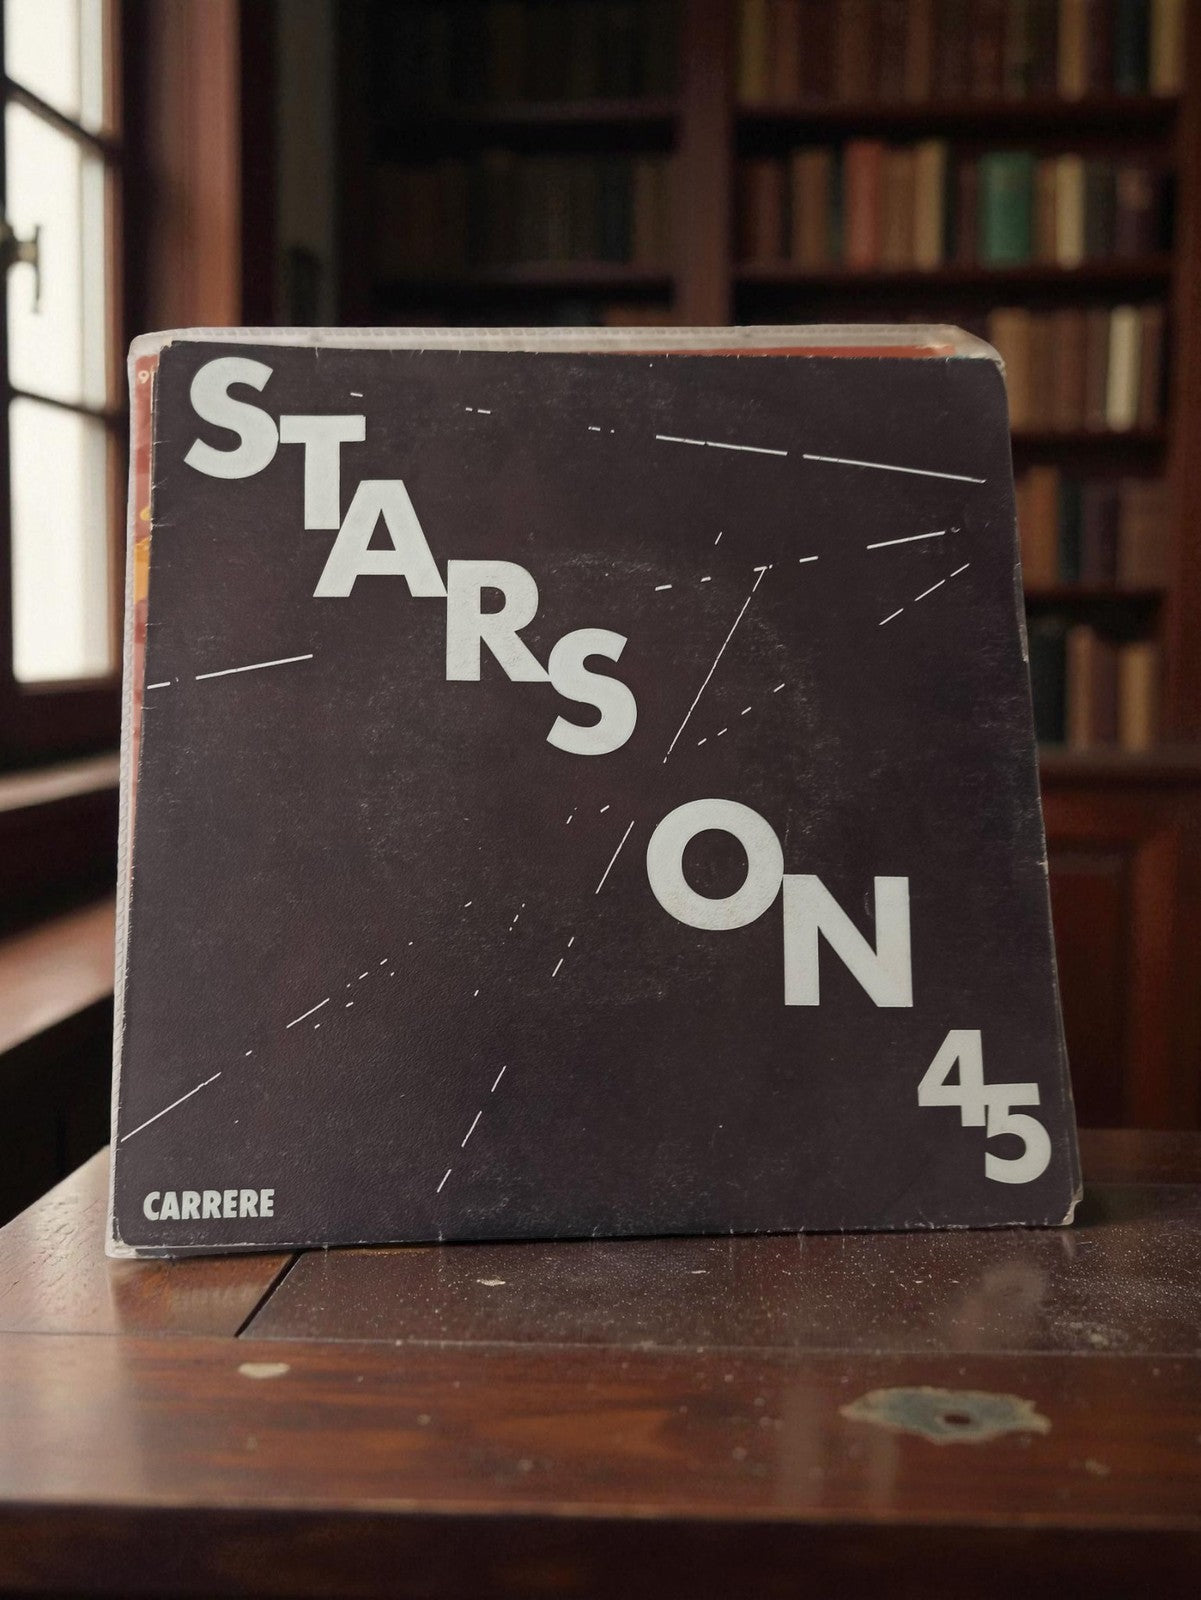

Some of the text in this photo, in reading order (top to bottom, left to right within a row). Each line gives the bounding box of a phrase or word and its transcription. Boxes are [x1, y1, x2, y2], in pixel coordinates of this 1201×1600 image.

[184, 357, 1051, 1184] STARS ON 45
[143, 1189, 275, 1221] CARRERE
